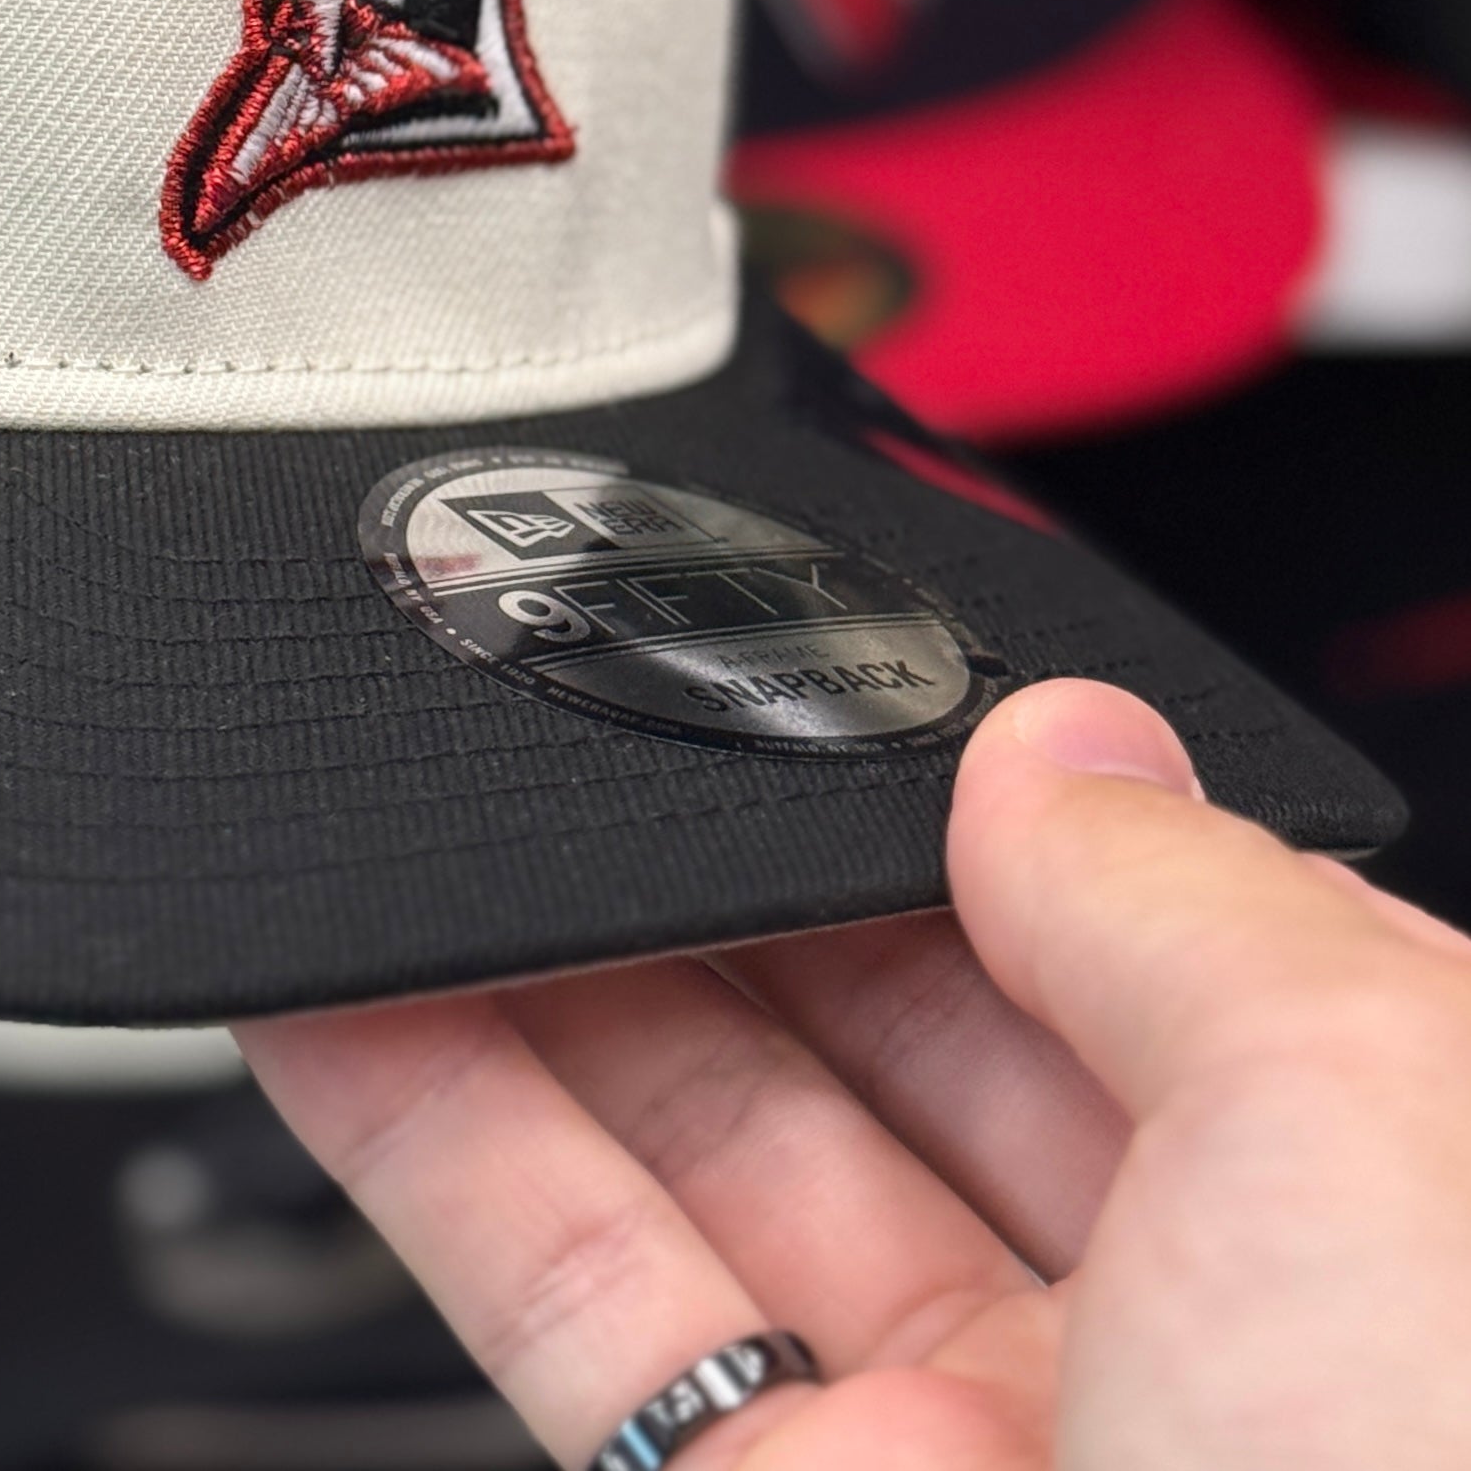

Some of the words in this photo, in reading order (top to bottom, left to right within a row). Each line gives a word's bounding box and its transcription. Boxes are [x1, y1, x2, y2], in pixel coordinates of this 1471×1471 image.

[574, 499, 657, 520] NEW
[600, 514, 684, 536] ERA
[497, 561, 849, 643] 9FIFTY
[459, 638, 502, 665] SINCE
[683, 659, 935, 713] SNAPBACK
